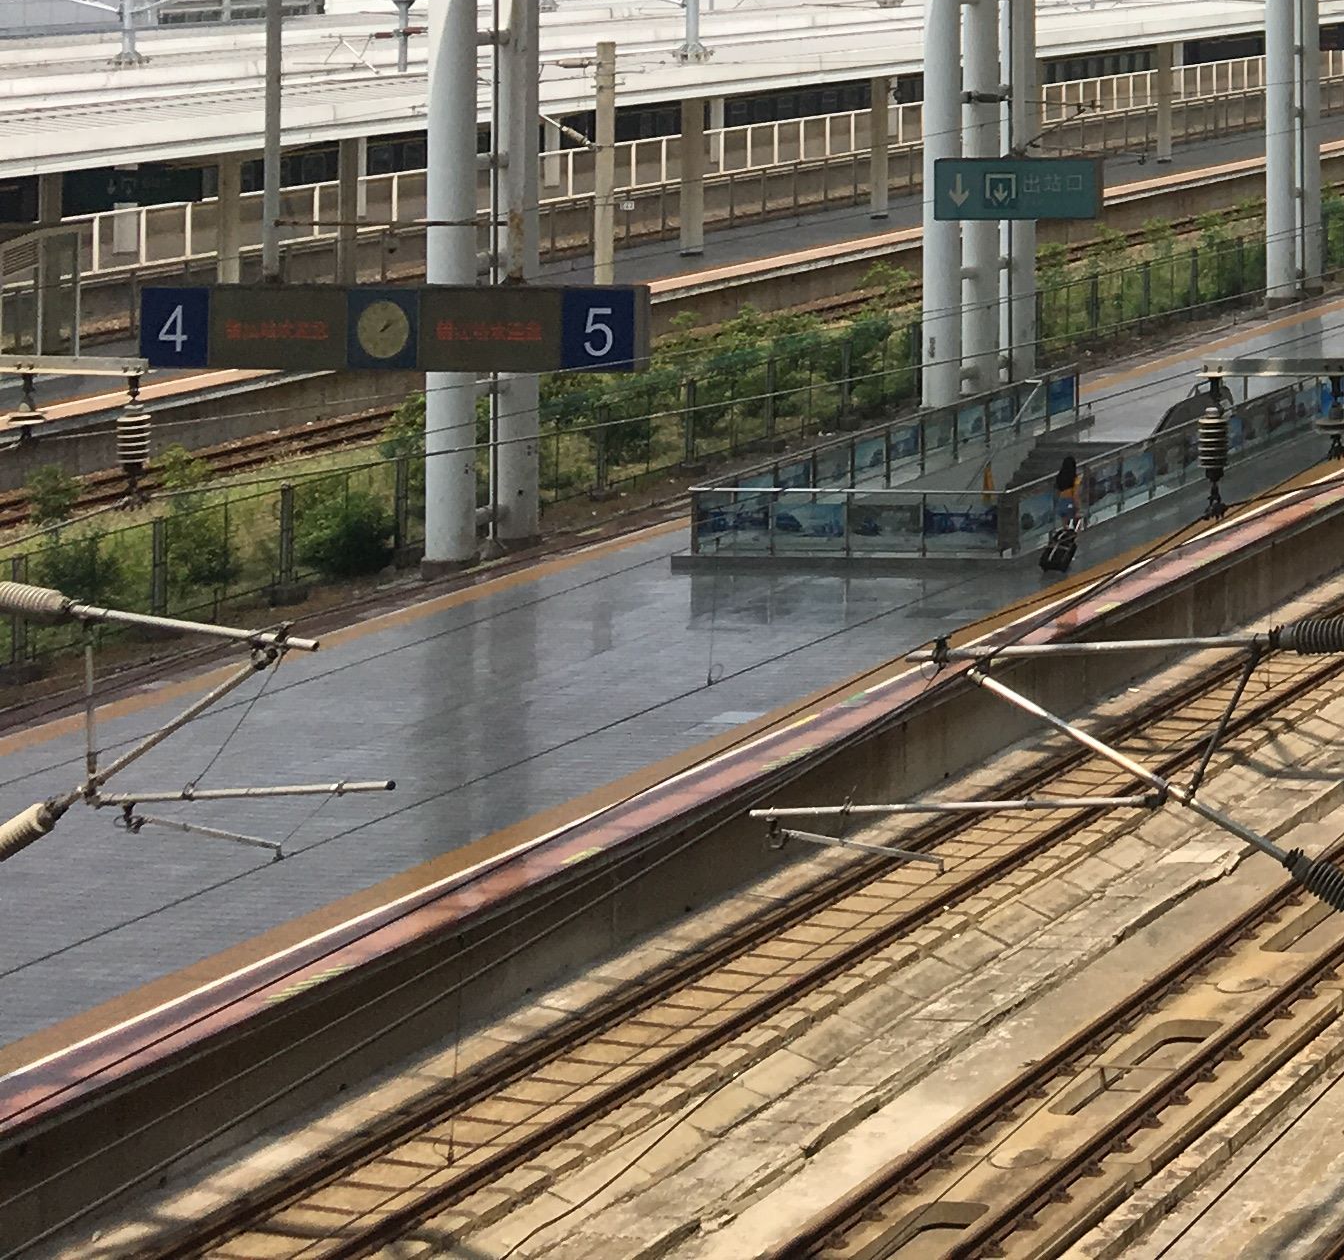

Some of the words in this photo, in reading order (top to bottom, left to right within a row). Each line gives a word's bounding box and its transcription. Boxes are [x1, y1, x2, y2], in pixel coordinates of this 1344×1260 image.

[1023, 173, 1082, 193] 出站口
[158, 304, 188, 352] 4
[583, 307, 613, 357] 5
